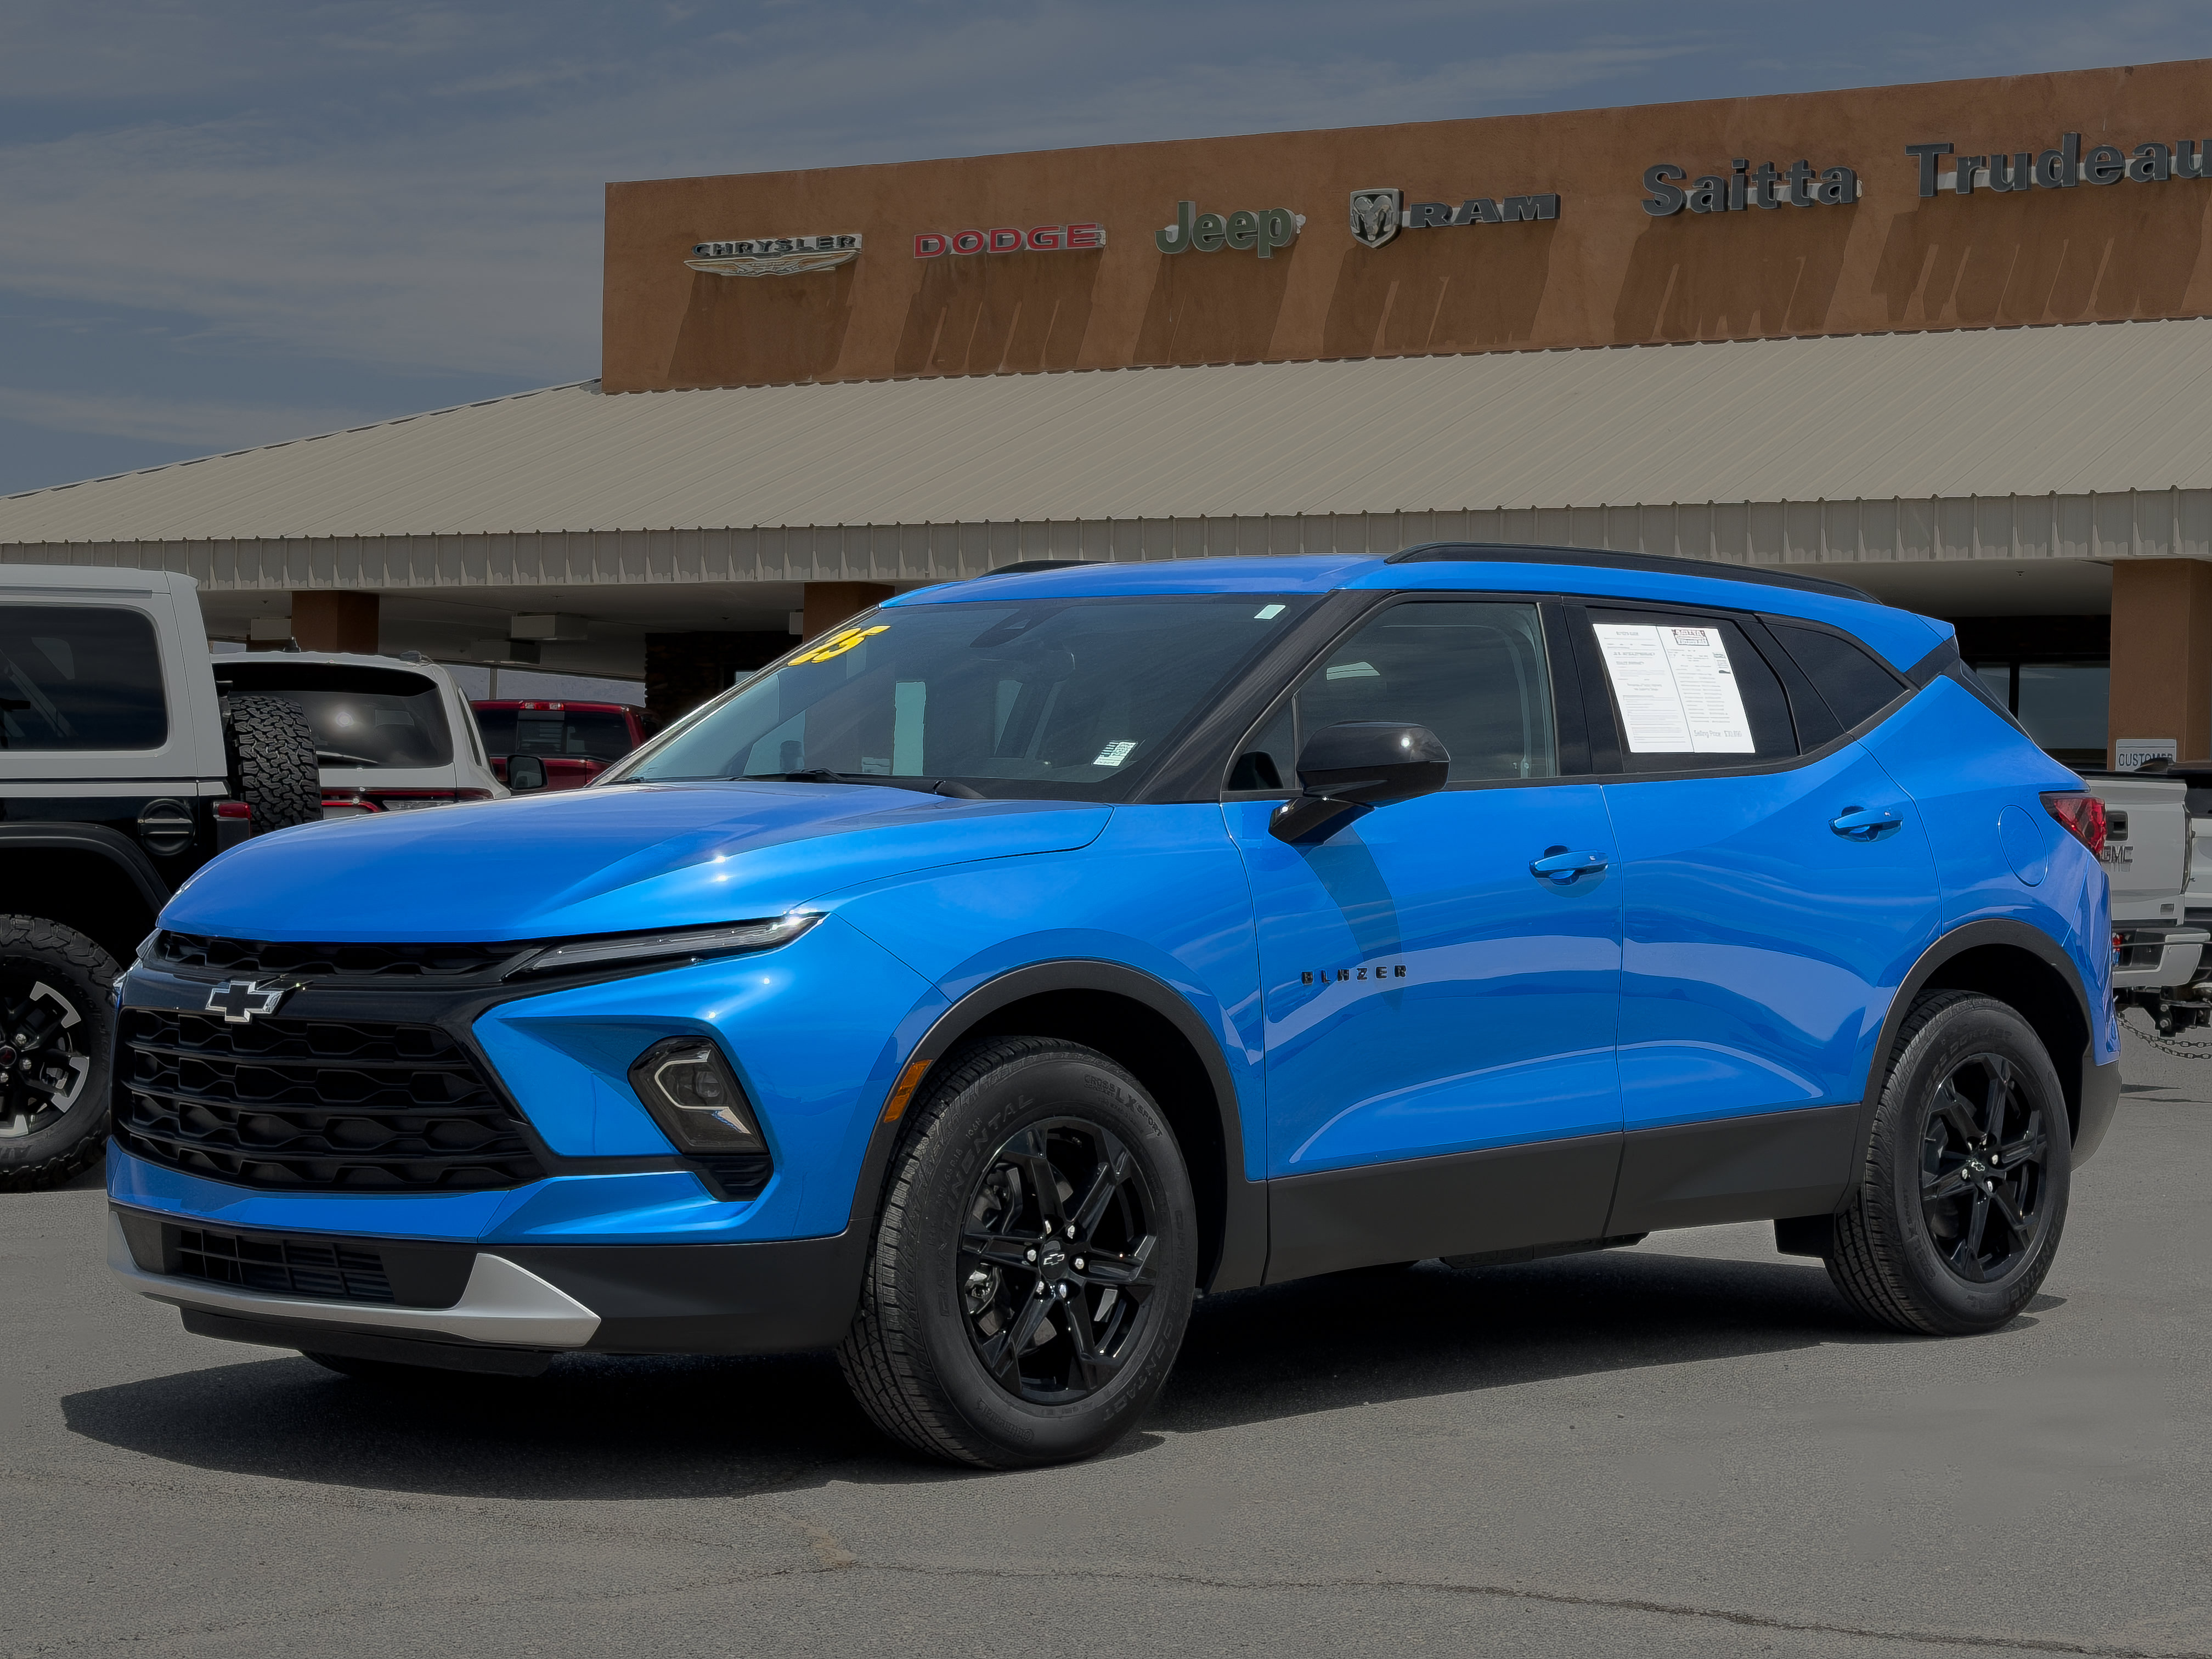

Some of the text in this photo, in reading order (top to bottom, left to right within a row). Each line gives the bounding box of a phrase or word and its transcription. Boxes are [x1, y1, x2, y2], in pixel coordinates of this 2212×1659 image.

[1641, 132, 2212, 216] Saitta Trudeau
[1409, 193, 1560, 228] RAM
[691, 234, 862, 257] CHRYSLER
[914, 223, 1105, 258] DODGE
[1155, 201, 1296, 258] Jeep
[2101, 845, 2134, 864] GMC
[1301, 965, 1407, 984] BLAZER
